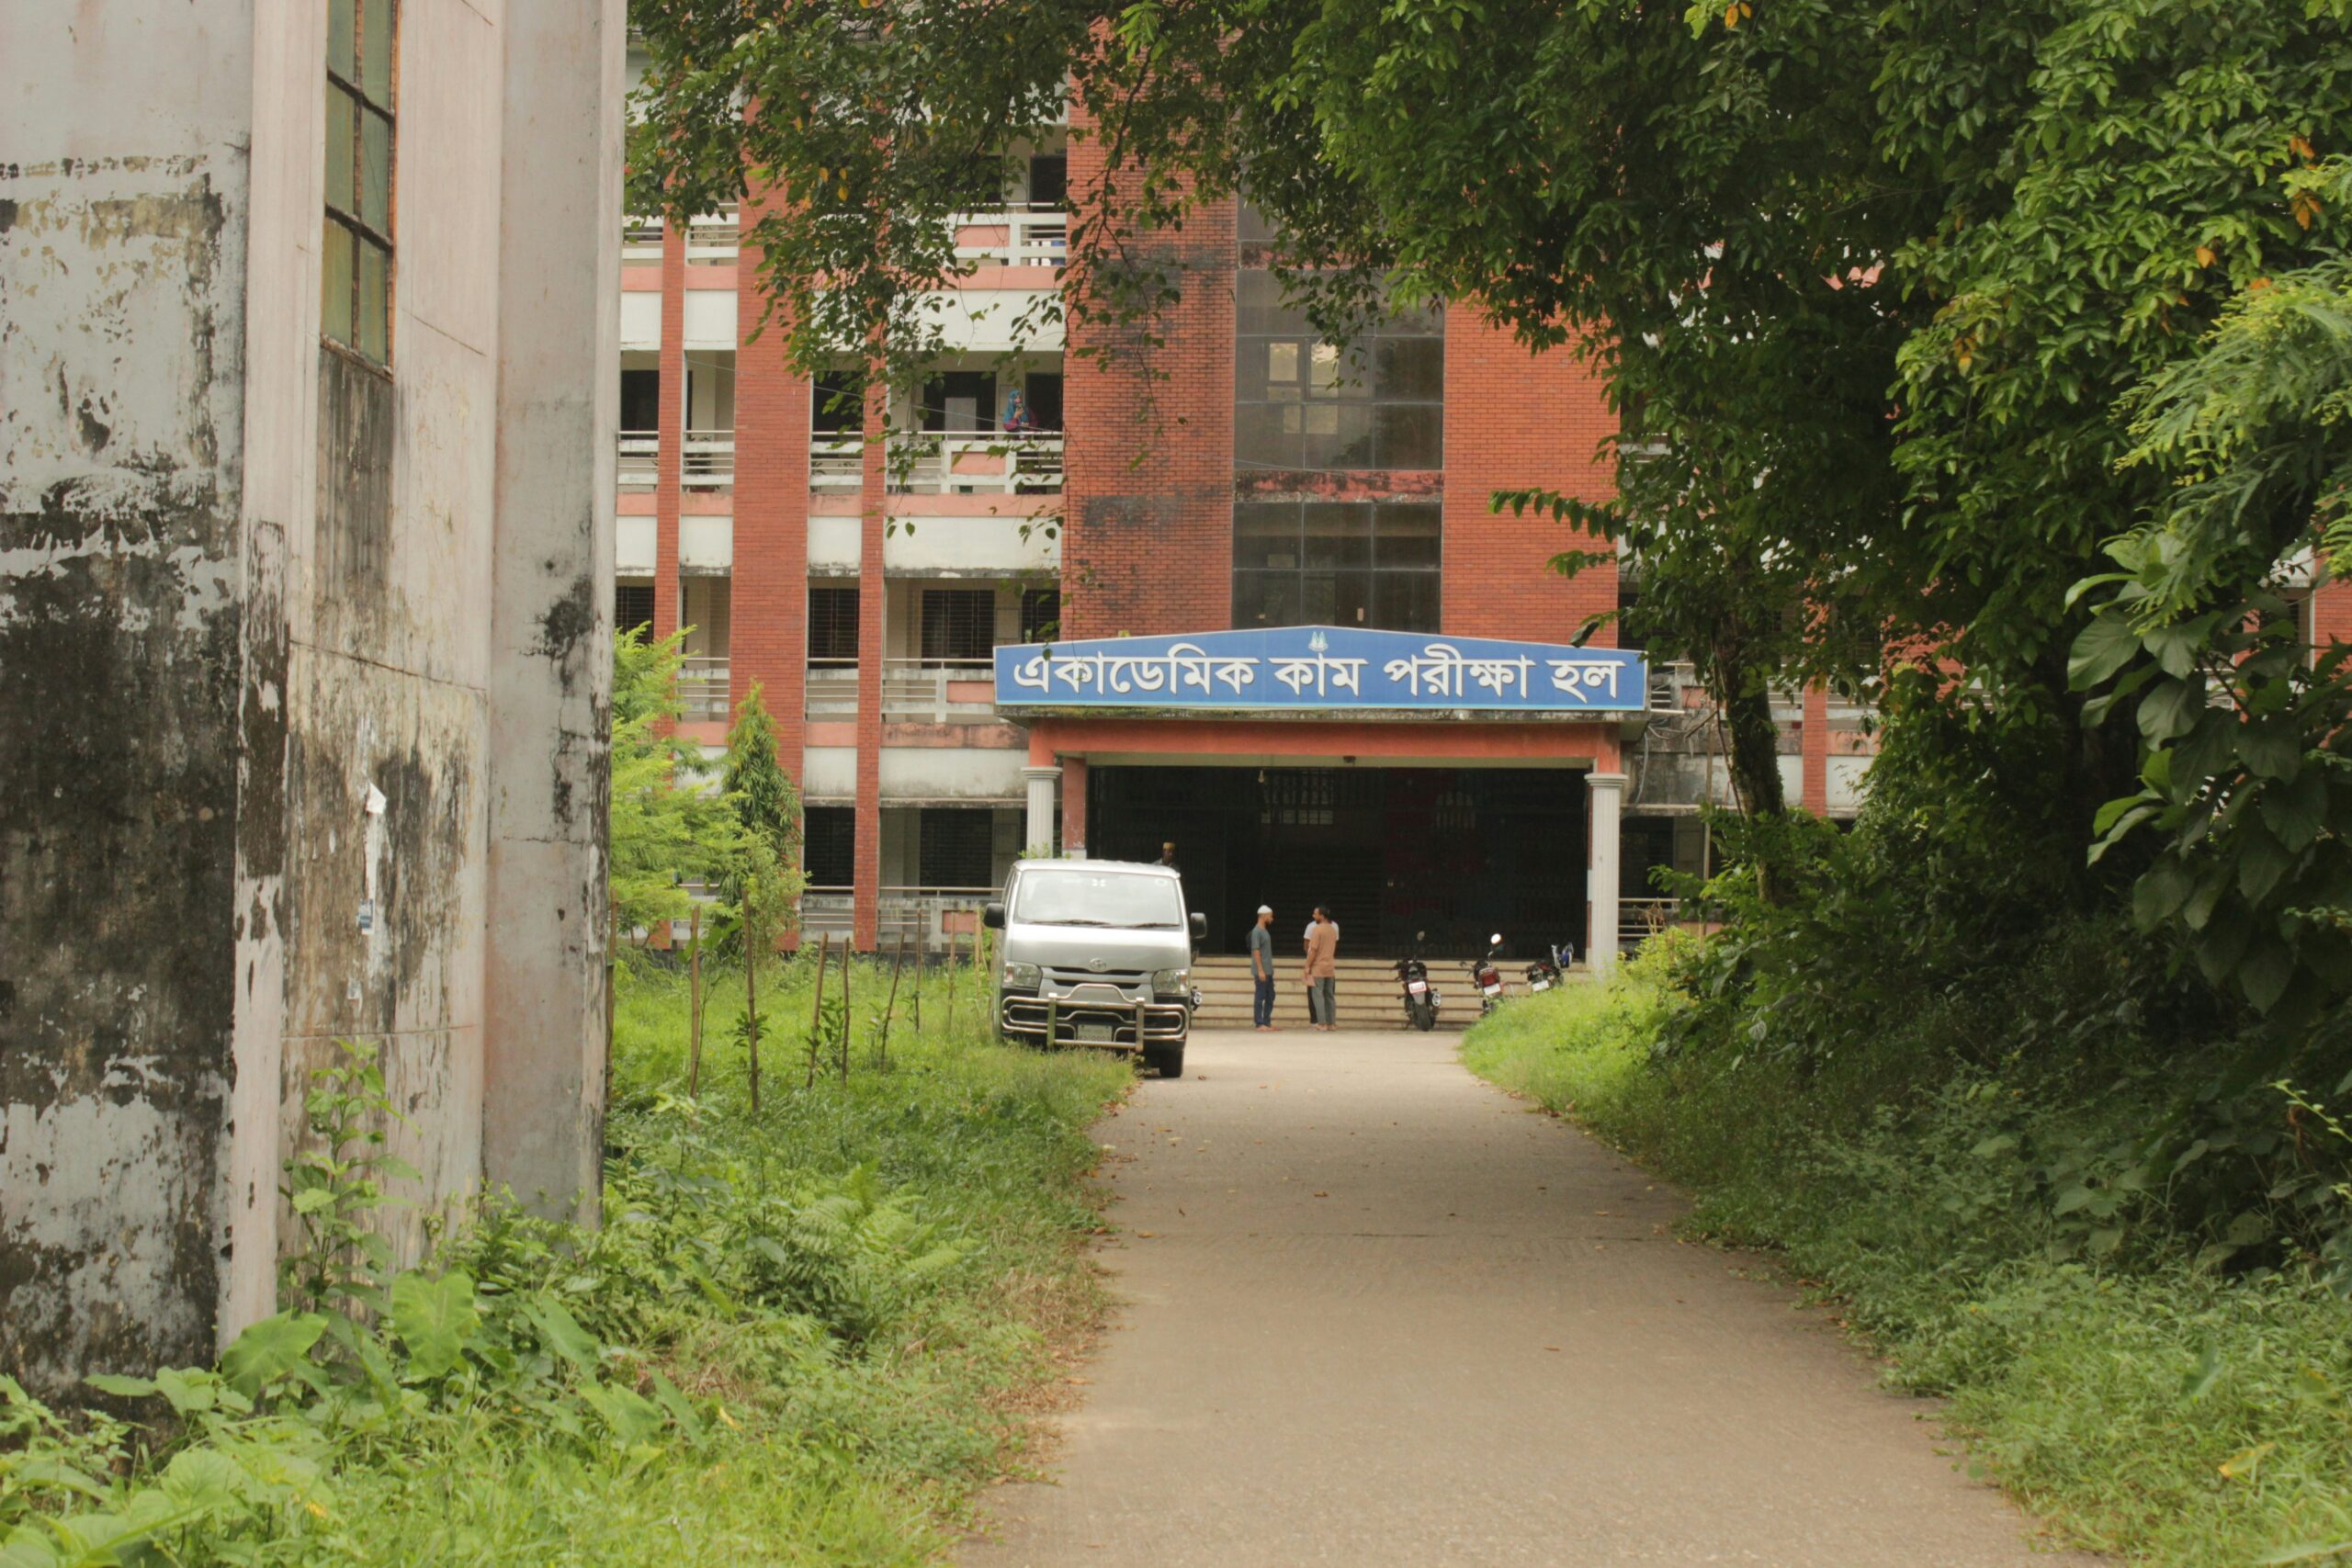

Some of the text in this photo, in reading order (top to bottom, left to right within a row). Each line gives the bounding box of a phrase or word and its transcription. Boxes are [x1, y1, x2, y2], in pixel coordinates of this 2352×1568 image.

[1013, 643, 1626, 704] একাডেমিক কাম পরীক্ষা হল
